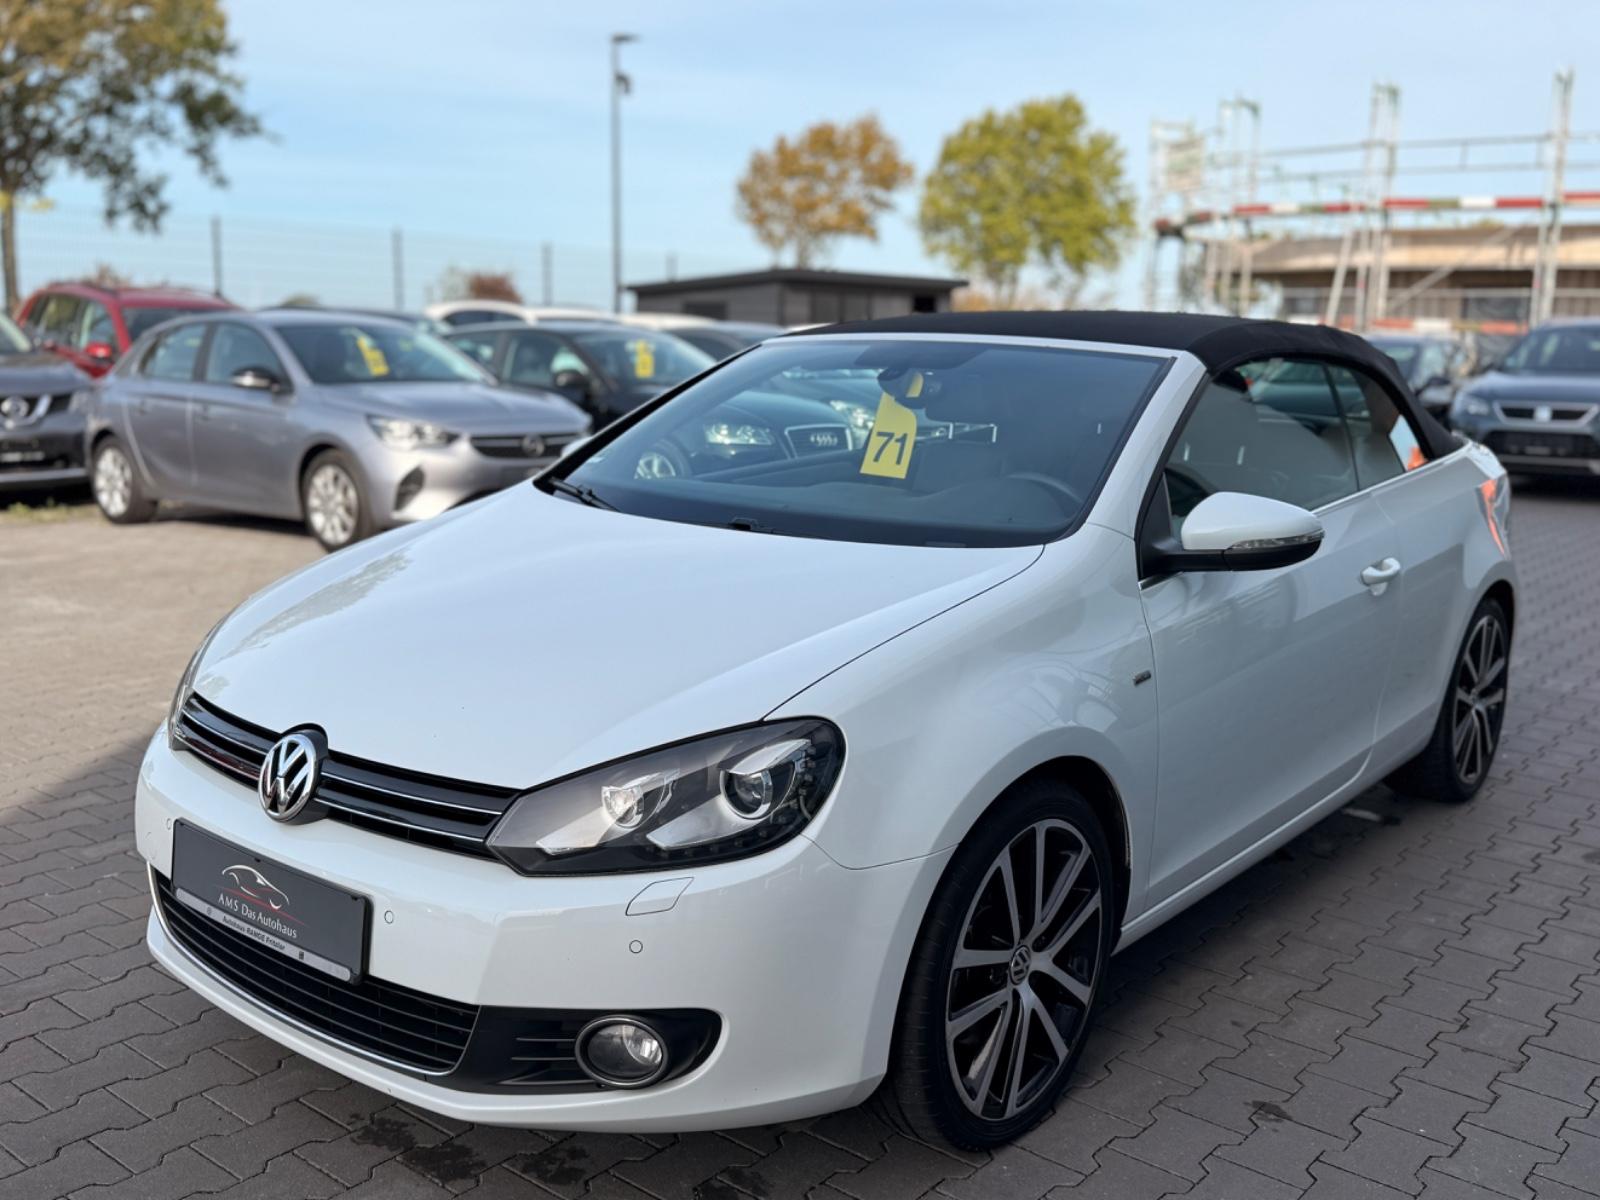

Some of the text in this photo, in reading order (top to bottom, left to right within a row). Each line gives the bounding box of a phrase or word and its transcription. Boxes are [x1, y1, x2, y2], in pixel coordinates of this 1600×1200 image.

[872, 431, 908, 465] 71
[218, 893, 298, 939] AMS Das Autohaus
